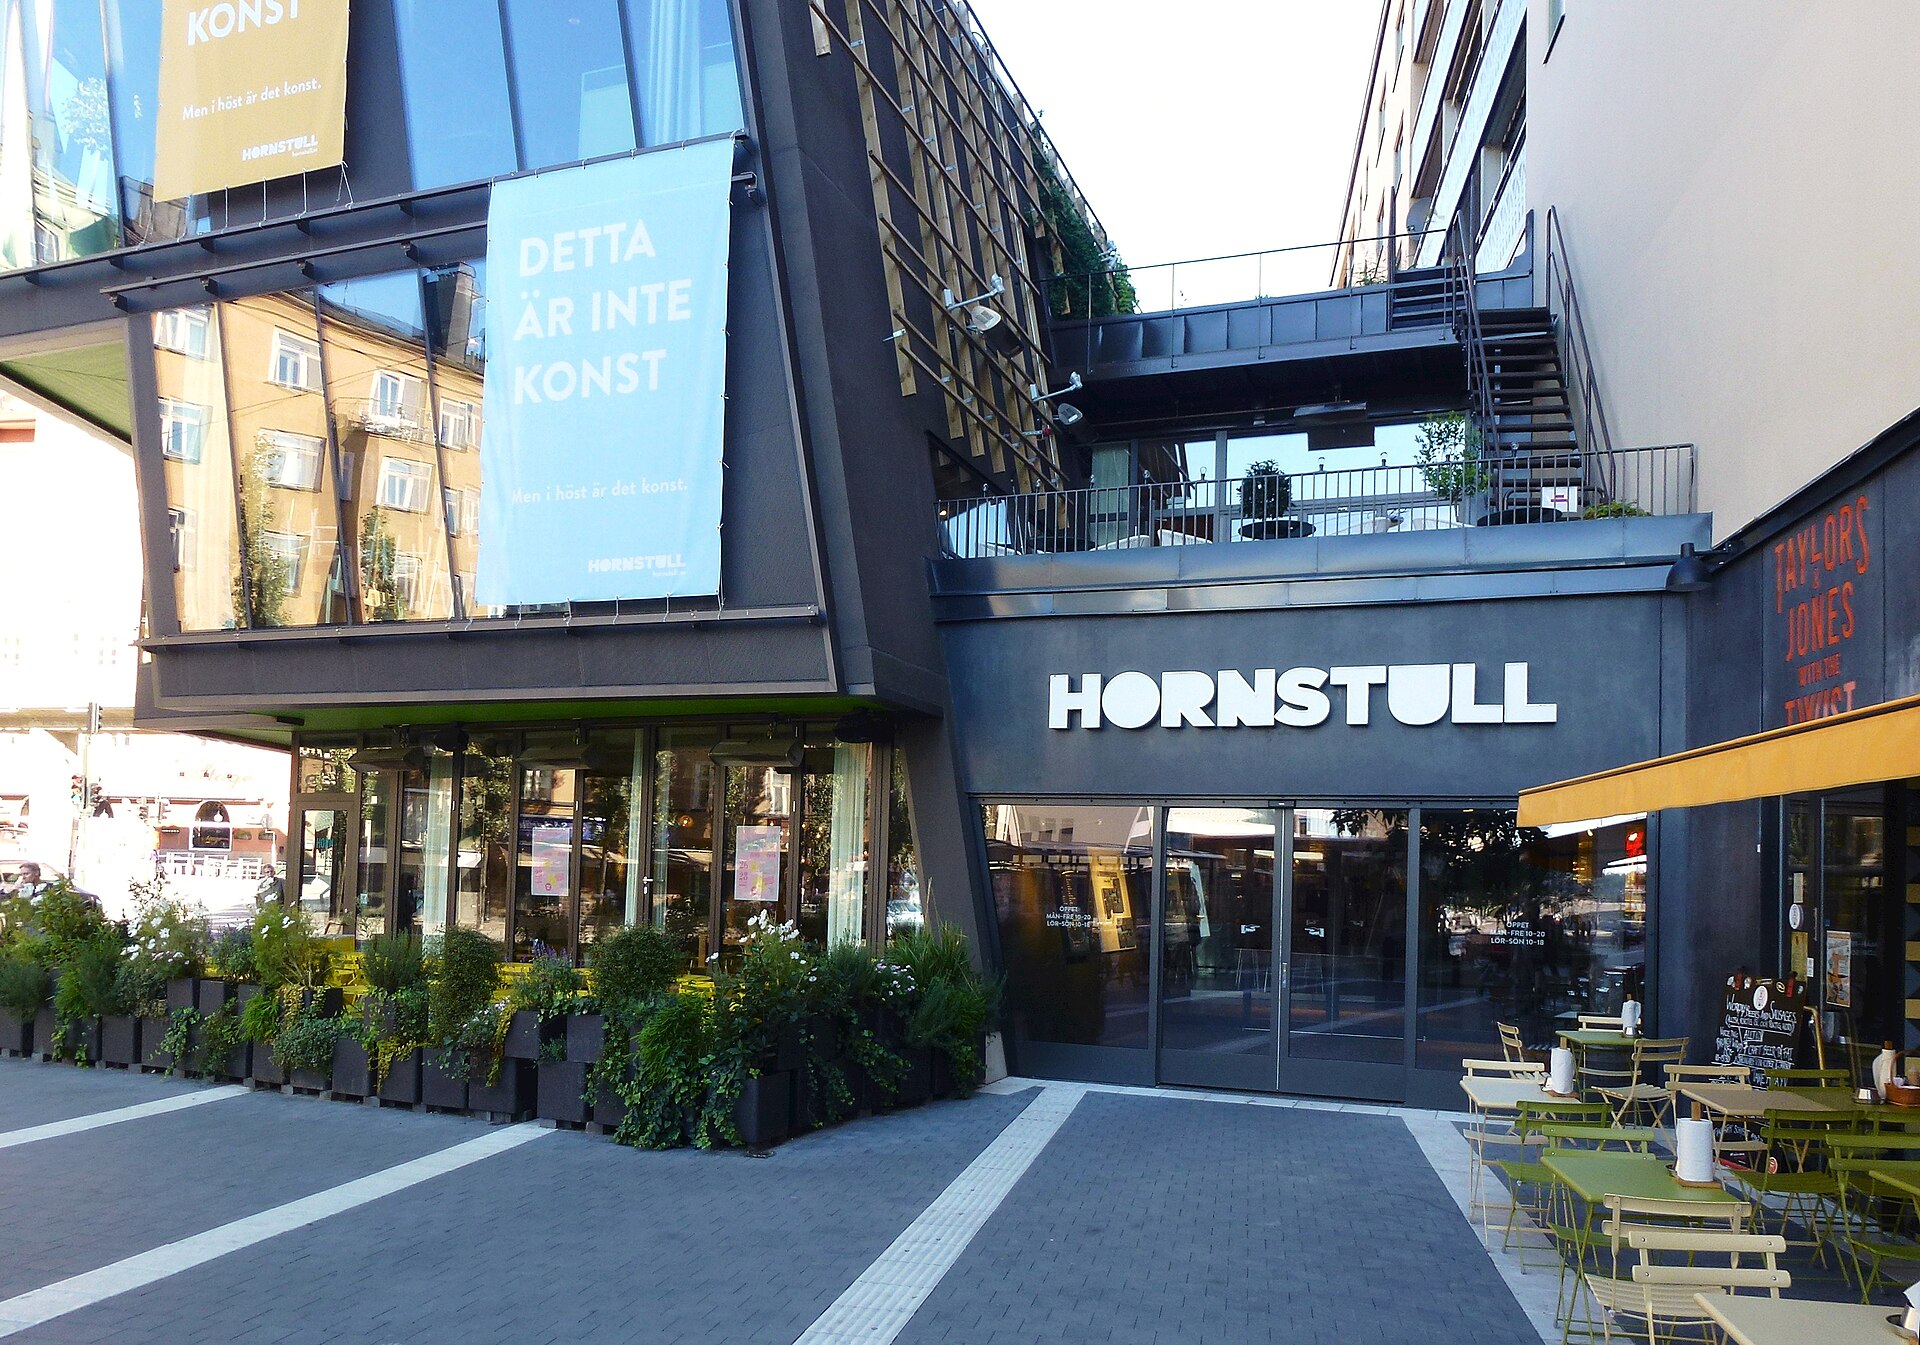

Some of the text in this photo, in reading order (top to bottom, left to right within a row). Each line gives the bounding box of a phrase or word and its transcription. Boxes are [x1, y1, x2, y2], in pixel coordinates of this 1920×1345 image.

[182, 78, 322, 120] Men i höst är det konst.
[242, 134, 319, 161] HORNSTULL
[519, 218, 656, 277] DETTA
[513, 278, 692, 341] ÄR INTE
[514, 349, 667, 405] KONST
[512, 489, 541, 505] Men
[556, 483, 587, 501] höst
[592, 482, 606, 498] är
[611, 480, 637, 496] det
[641, 477, 688, 495] konst.
[588, 554, 687, 573] HORNSTULL
[1775, 495, 1869, 615] TAYLORS
[1785, 580, 1855, 662] JONES
[1048, 661, 1558, 730] HORNSTULL
[1798, 665, 1822, 687] WITH
[1490, 936, 1524, 945] LÖR-SÖN
[1525, 930, 1545, 938] 10-20
